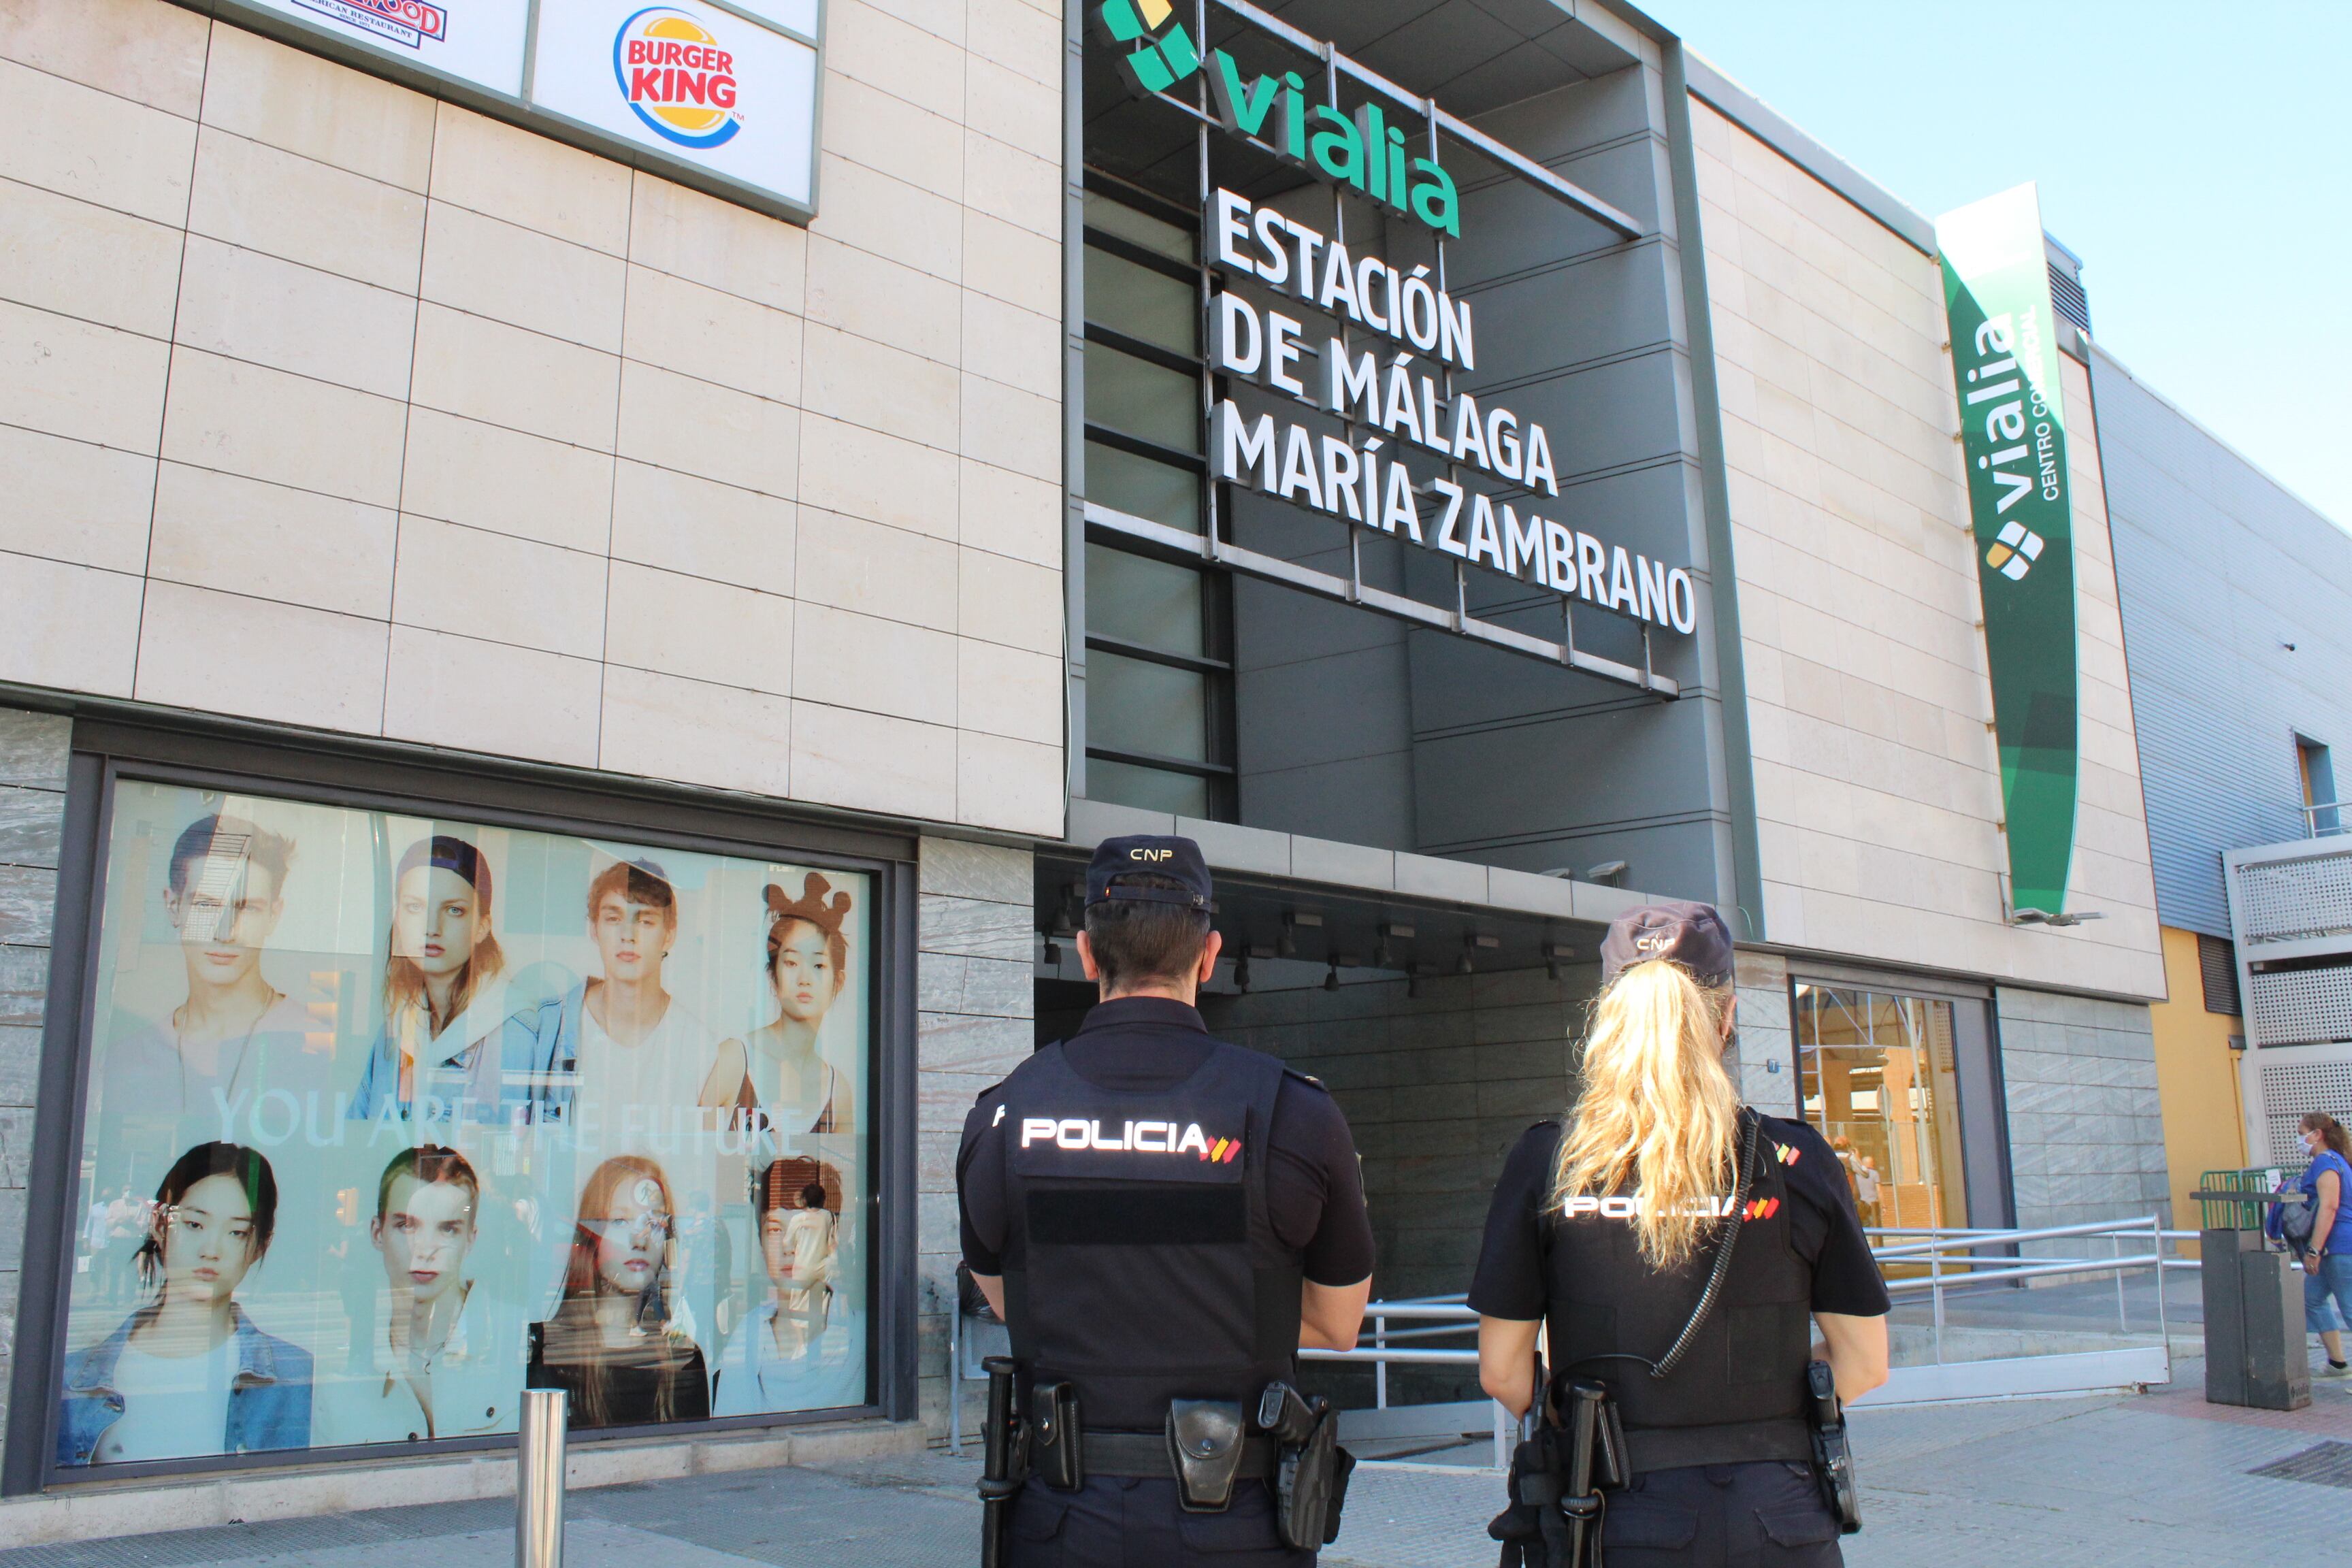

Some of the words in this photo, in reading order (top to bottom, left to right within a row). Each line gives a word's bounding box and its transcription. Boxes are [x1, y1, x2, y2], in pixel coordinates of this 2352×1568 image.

[340, 13, 357, 23] SINCE
[350, 10, 412, 38] RESTAURANT
[628, 40, 733, 75] BURGER
[631, 67, 736, 109] KING
[1214, 48, 1460, 238] vialia
[1218, 187, 1474, 371] ESTACIÓN
[1221, 291, 1303, 395] DE
[1330, 337, 1558, 497] MÁLAGA
[1967, 312, 2033, 515] vialia
[2034, 422, 2059, 501] CENTRO
[1223, 399, 1422, 543] MARÍA
[1435, 478, 1697, 636] ZAMBRANO
[1130, 848, 1173, 862] CNP
[1637, 938, 1676, 951] CNP
[212, 1086, 346, 1148] YOU
[367, 1092, 480, 1150] ARE
[500, 1097, 600, 1152] THE
[621, 1103, 802, 1156] FUTURE
[1022, 1118, 1209, 1154] POLICIA
